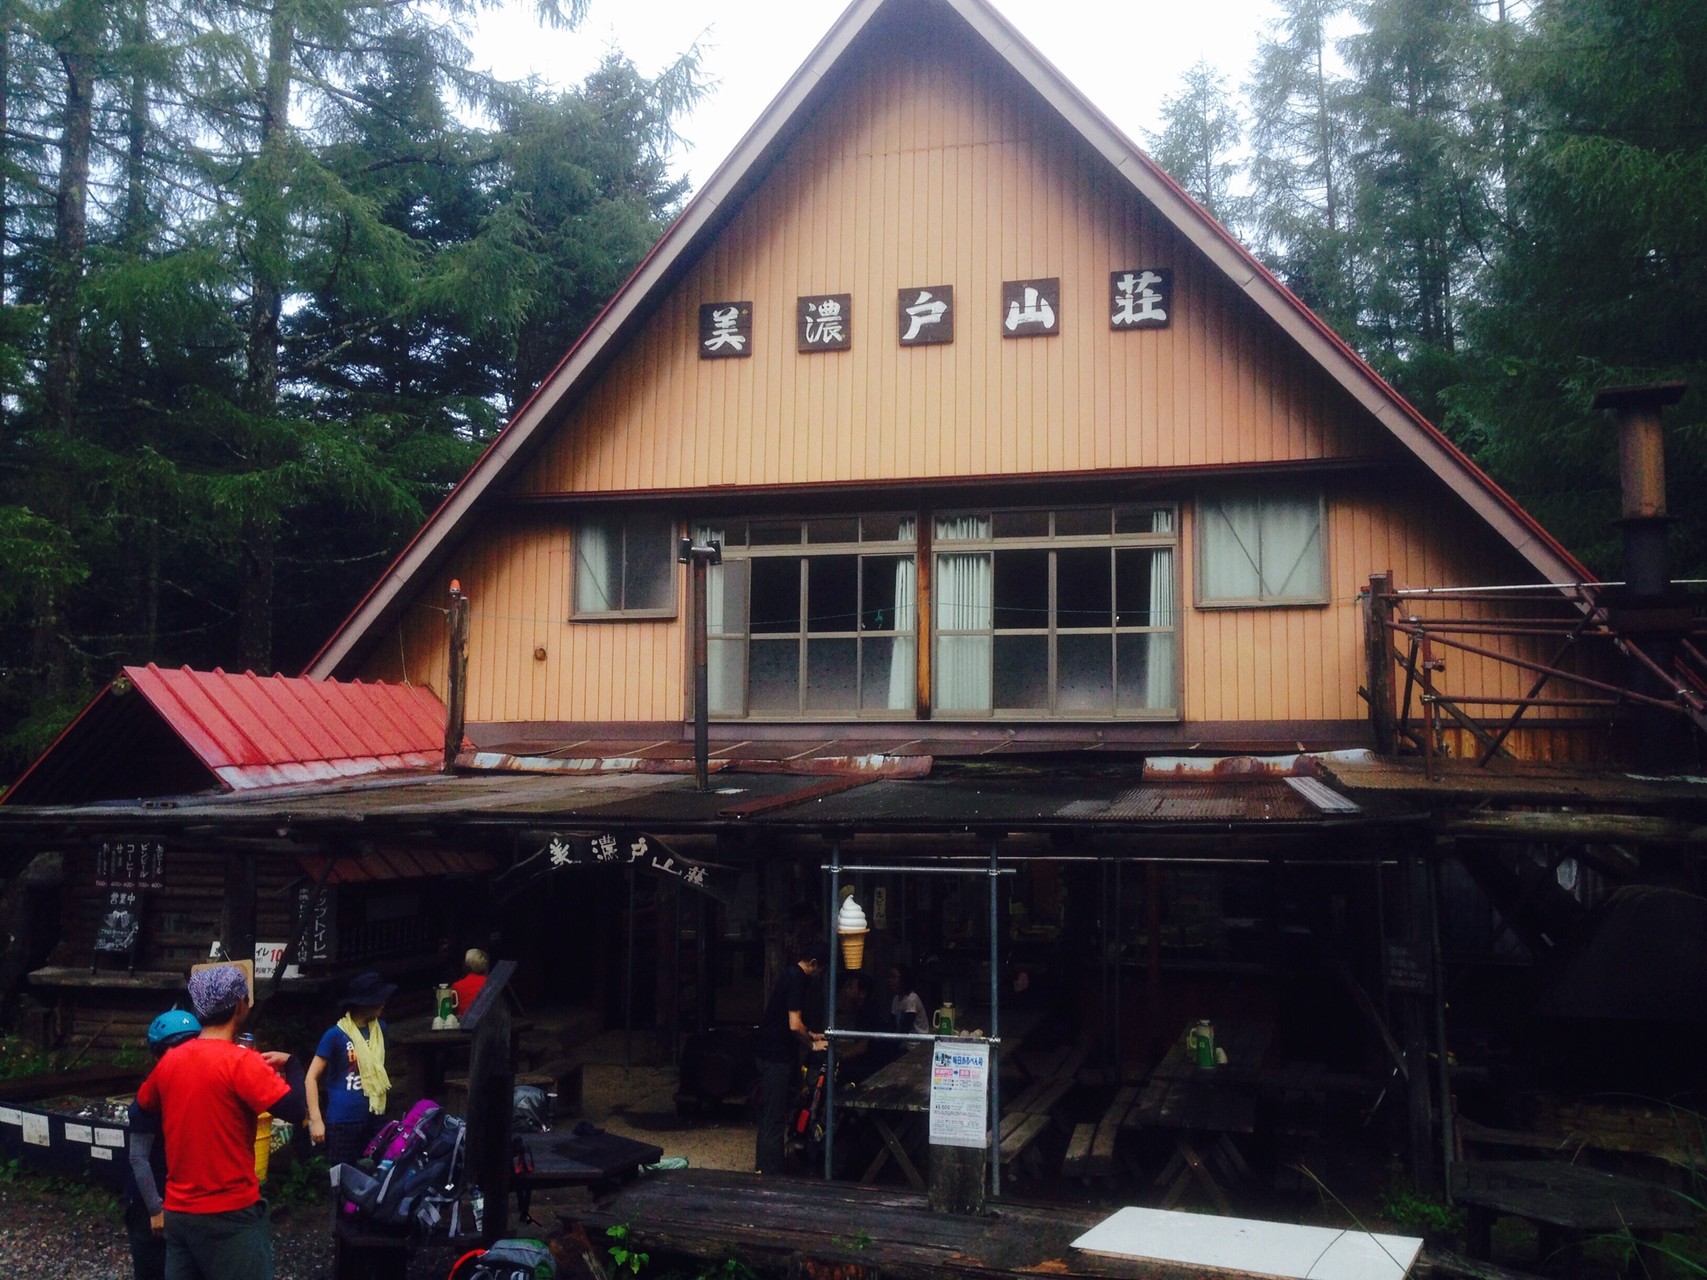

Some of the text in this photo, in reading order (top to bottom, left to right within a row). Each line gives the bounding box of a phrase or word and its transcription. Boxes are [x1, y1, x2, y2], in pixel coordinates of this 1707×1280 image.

[704, 270, 1168, 352] 美濃戸山荘
[126, 844, 135, 878] コーヒー
[110, 892, 136, 905] 営業中
